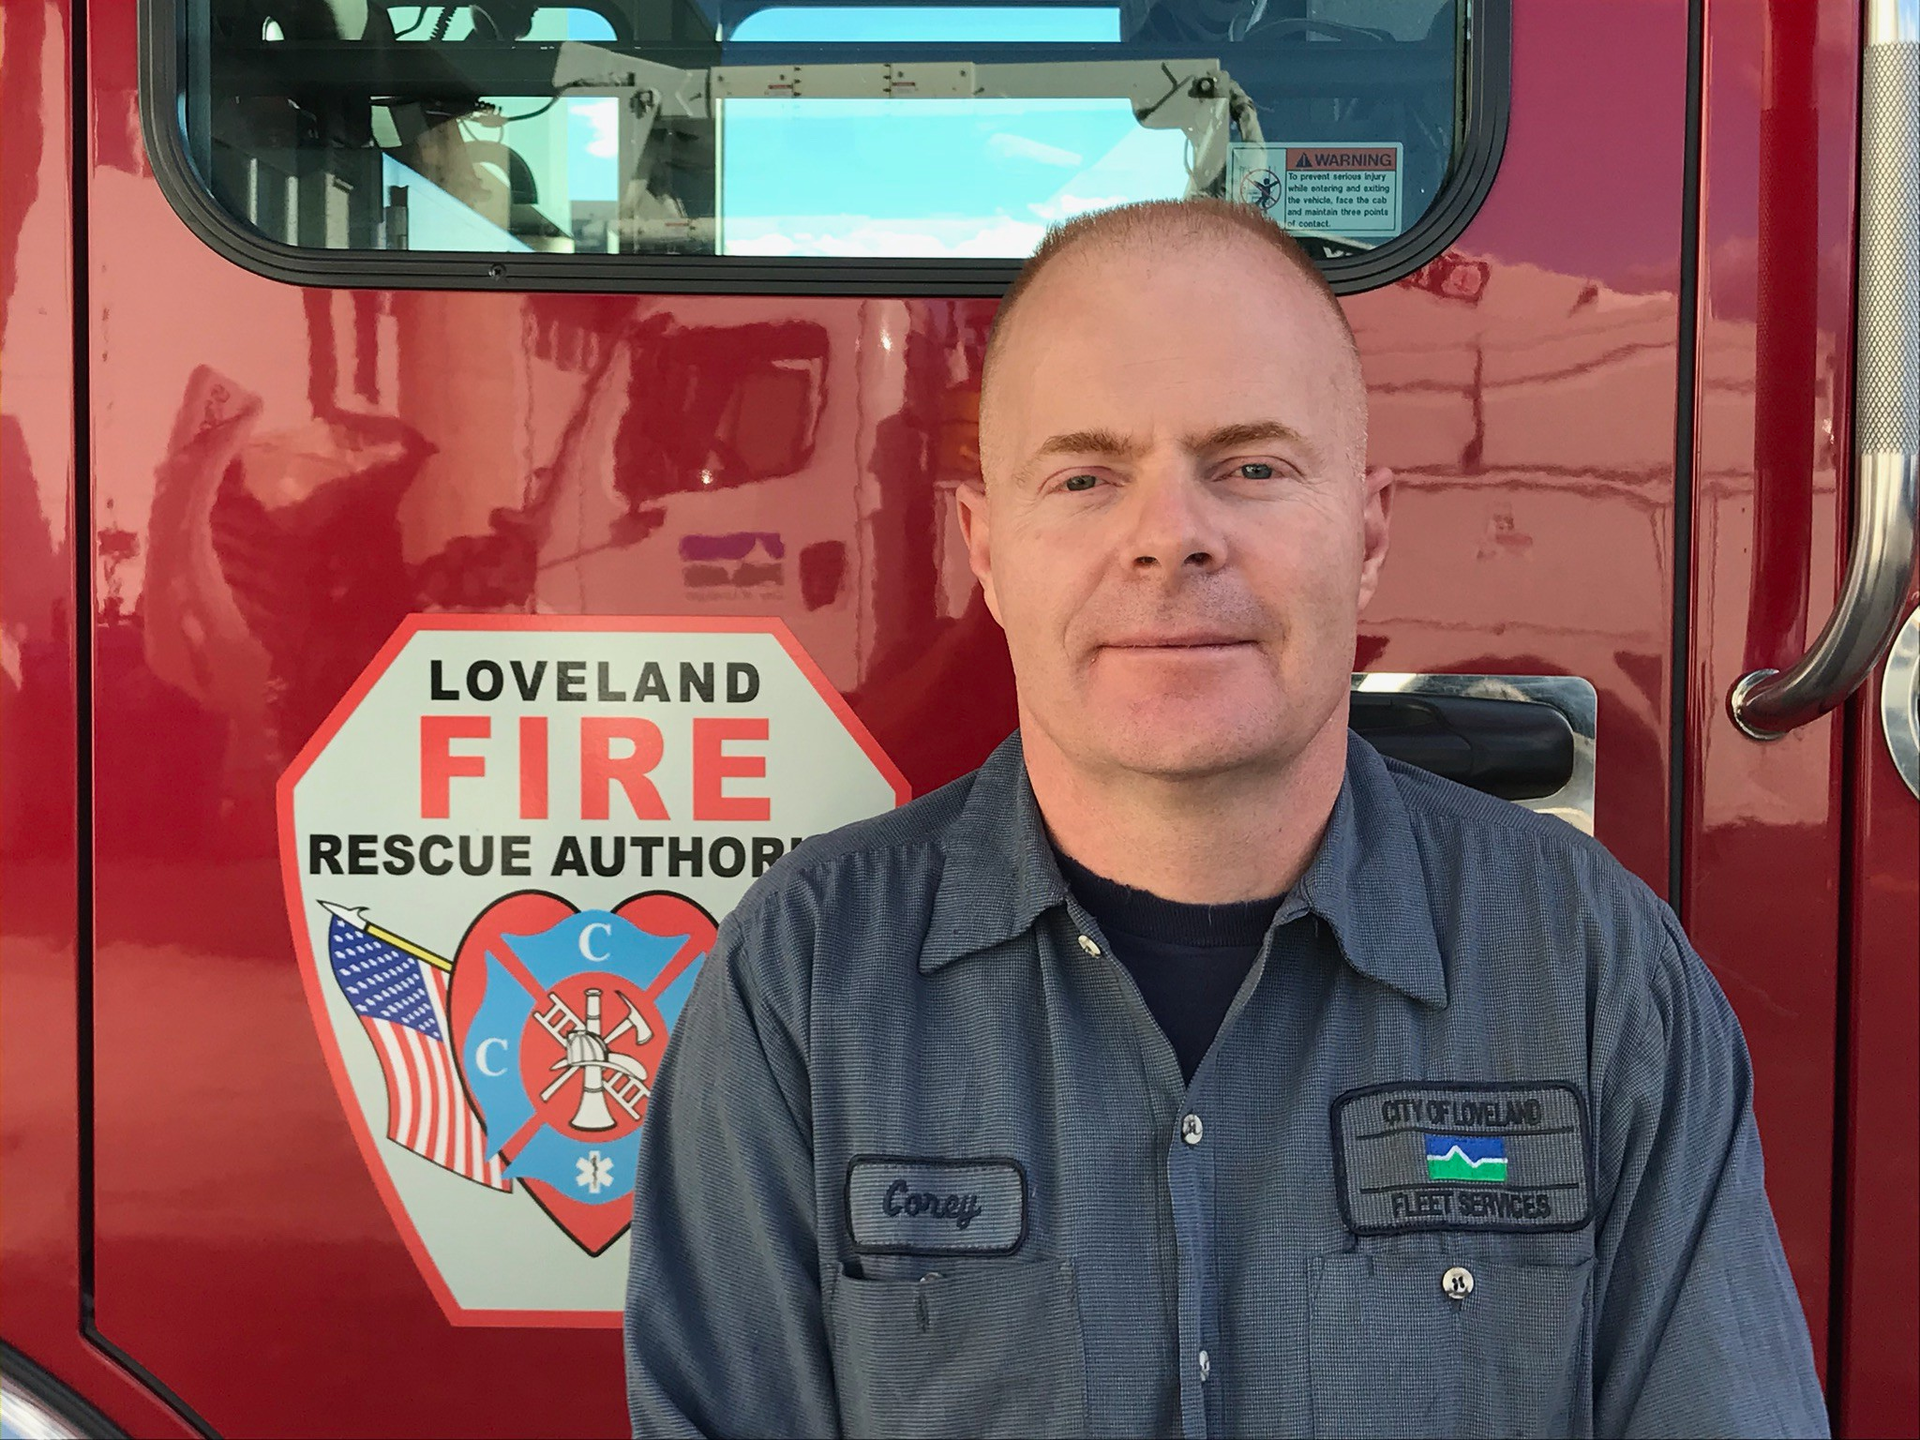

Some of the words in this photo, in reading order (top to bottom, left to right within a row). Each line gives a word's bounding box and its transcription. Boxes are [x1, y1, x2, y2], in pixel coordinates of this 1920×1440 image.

[1315, 153, 1392, 167] WARNING
[1288, 172, 1298, 180] To
[1301, 172, 1330, 182] prevent
[1333, 172, 1361, 180] serious
[1364, 172, 1387, 182] injury
[1288, 184, 1308, 192] while
[1311, 184, 1343, 193] entering
[1346, 184, 1361, 192] and
[1364, 184, 1390, 193] exiting
[1287, 196, 1300, 204] the
[1303, 196, 1333, 205] vehicle,
[1336, 196, 1353, 204] face
[1356, 196, 1369, 204] the
[1372, 196, 1388, 204] cab
[1287, 208, 1302, 216] and
[1305, 208, 1338, 216] maintain
[1341, 208, 1361, 216] three
[1364, 208, 1389, 217] points
[1287, 220, 1296, 228] of
[1298, 220, 1331, 228] contact.
[430, 659, 761, 704] LOVELAND
[420, 715, 772, 822] FIRE
[309, 834, 533, 877] RESCUE
[578, 922, 612, 962] C
[475, 1037, 509, 1077] C
[1382, 1100, 1423, 1124] CITY
[1427, 1100, 1450, 1125] OF
[1453, 1099, 1542, 1127] LOVELAND
[882, 1179, 982, 1230] Corey
[1392, 1191, 1454, 1217] FLEET
[1458, 1192, 1550, 1219] SERVICES
